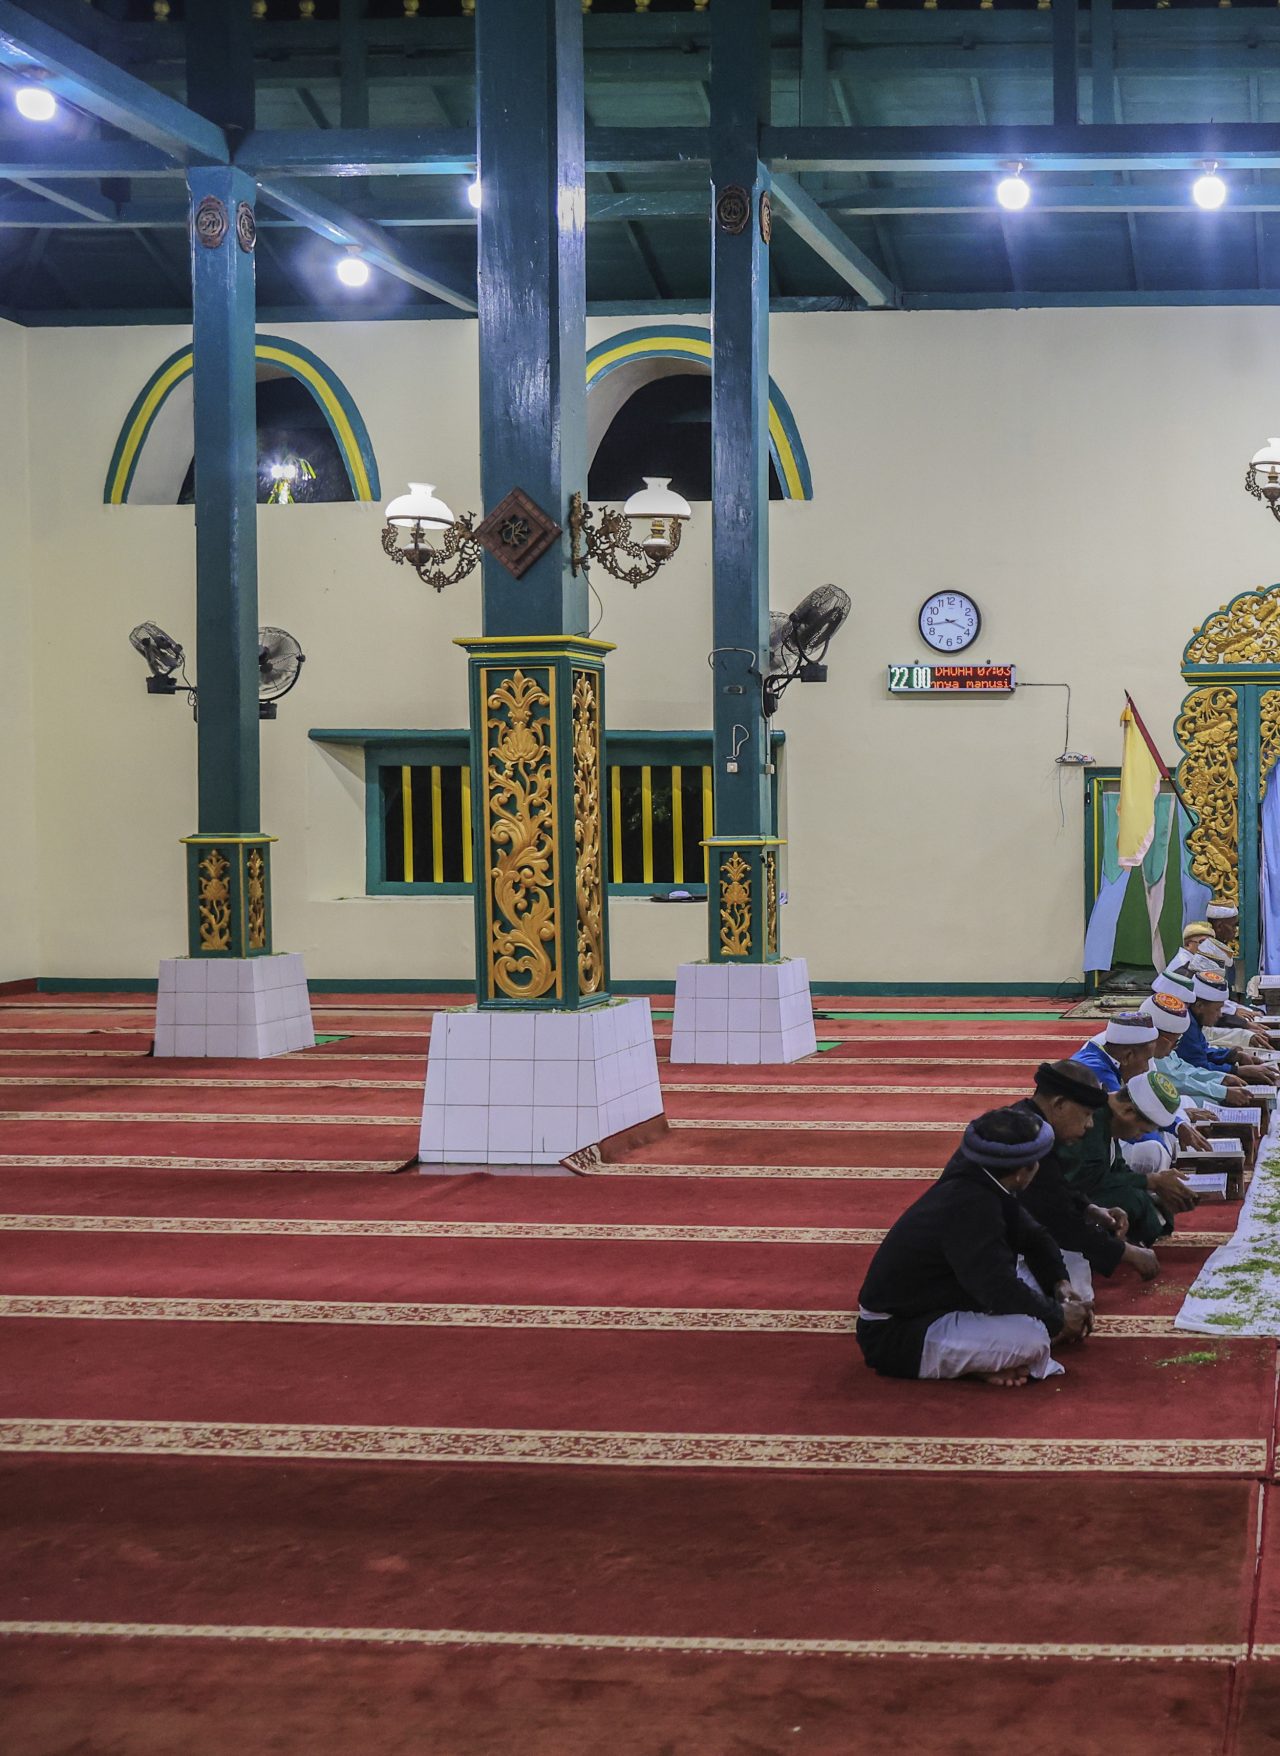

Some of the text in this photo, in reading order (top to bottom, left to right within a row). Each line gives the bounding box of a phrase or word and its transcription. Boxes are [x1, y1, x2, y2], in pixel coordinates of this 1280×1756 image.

[946, 596, 956, 606] 12
[930, 607, 939, 615] 10
[965, 608, 971, 616] 2
[927, 617, 933, 625] 9
[967, 618, 974, 626] 3
[929, 627, 935, 635] 8
[964, 628, 970, 636] 4
[938, 635, 943, 643] 7
[946, 638, 952, 646] 6
[956, 636, 963, 644] 5
[890, 667, 930, 688] 22 00
[966, 678, 1011, 688] manusi
